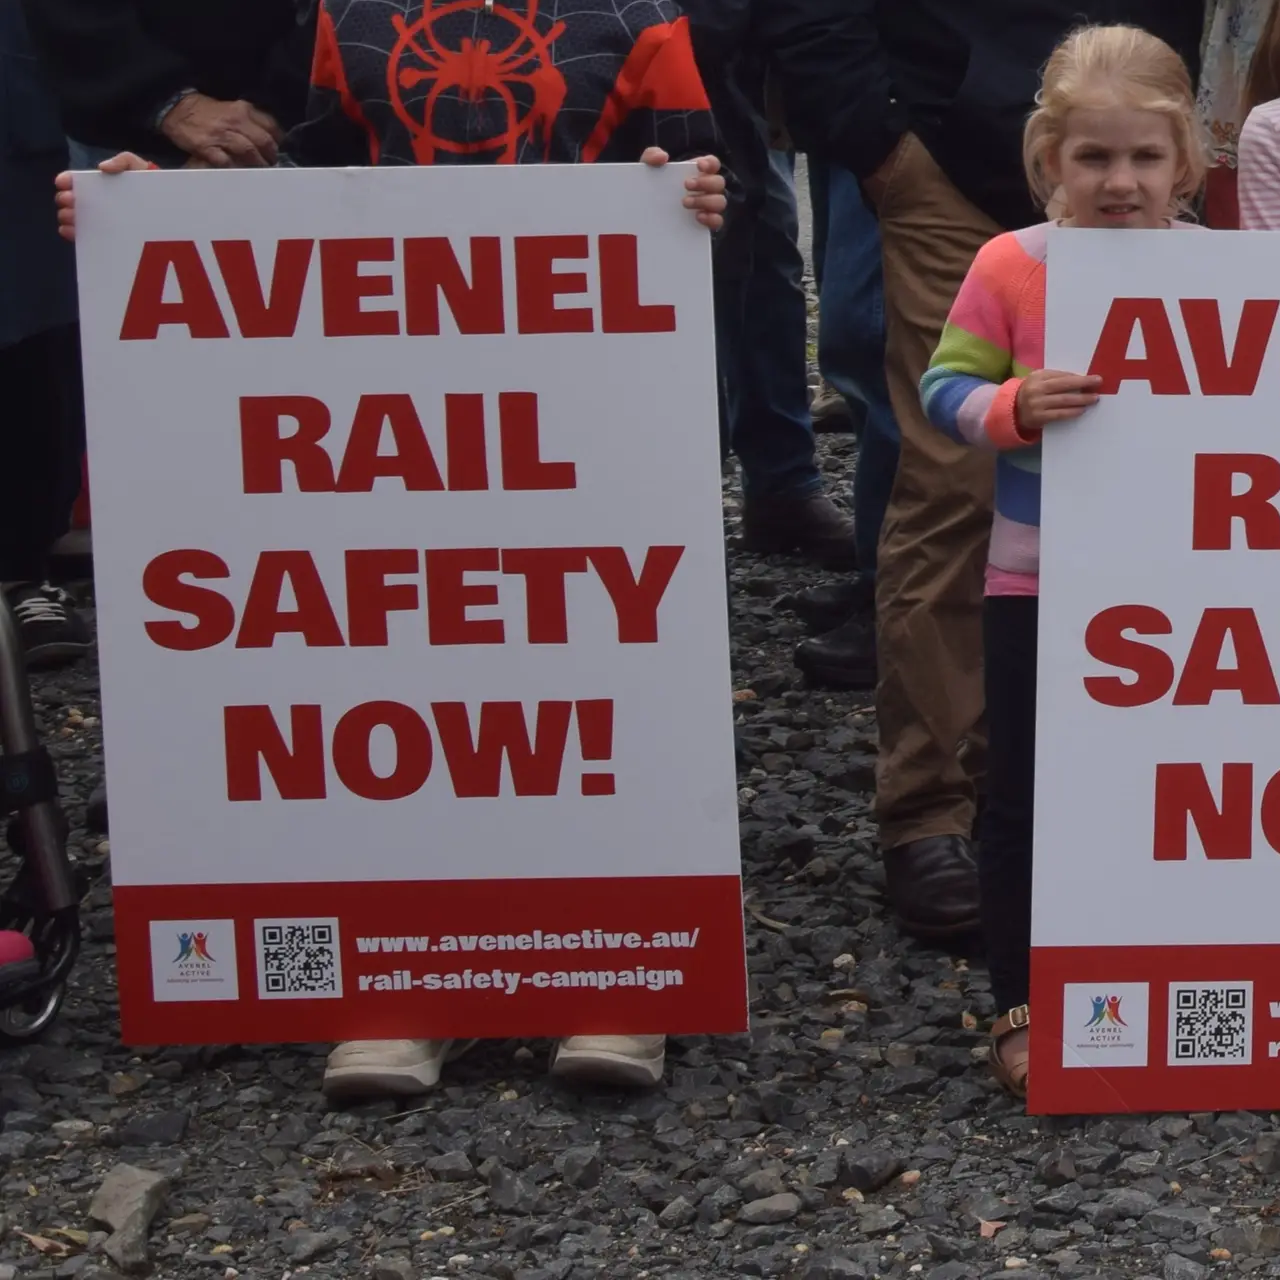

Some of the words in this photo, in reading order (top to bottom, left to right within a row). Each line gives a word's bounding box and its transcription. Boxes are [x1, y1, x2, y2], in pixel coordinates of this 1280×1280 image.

[120, 234, 675, 340] AVENEL
[241, 392, 576, 494] RAIL
[143, 546, 685, 650] SAFETY
[225, 699, 616, 802] NOW!
[356, 927, 699, 952] www.avenelactive.au/
[359, 966, 684, 996] rail-safety-campaign
